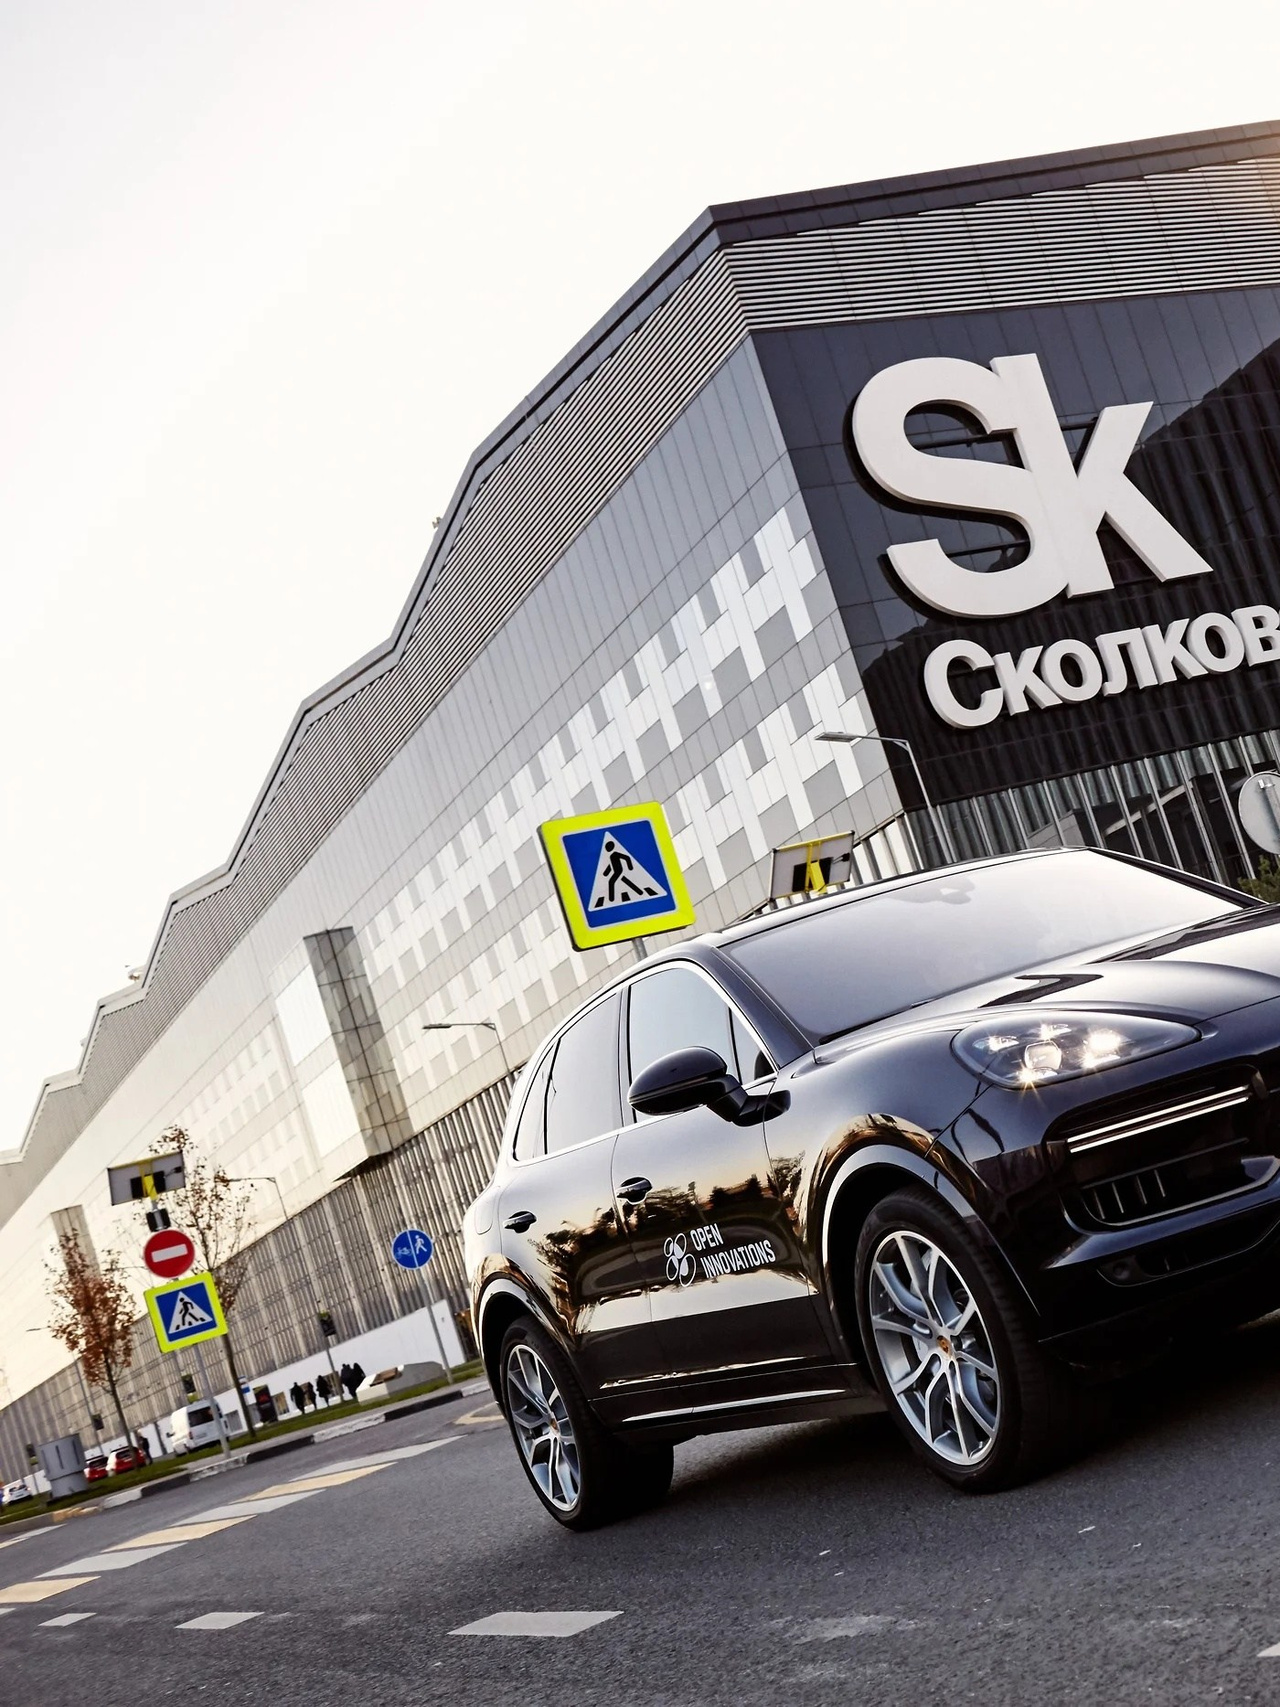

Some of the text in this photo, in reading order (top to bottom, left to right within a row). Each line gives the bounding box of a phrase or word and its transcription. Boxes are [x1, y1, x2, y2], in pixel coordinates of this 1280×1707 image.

[852, 352, 1214, 620] Sk
[689, 1222, 725, 1252] OPEN
[699, 1239, 777, 1280] INNOVATIONS
